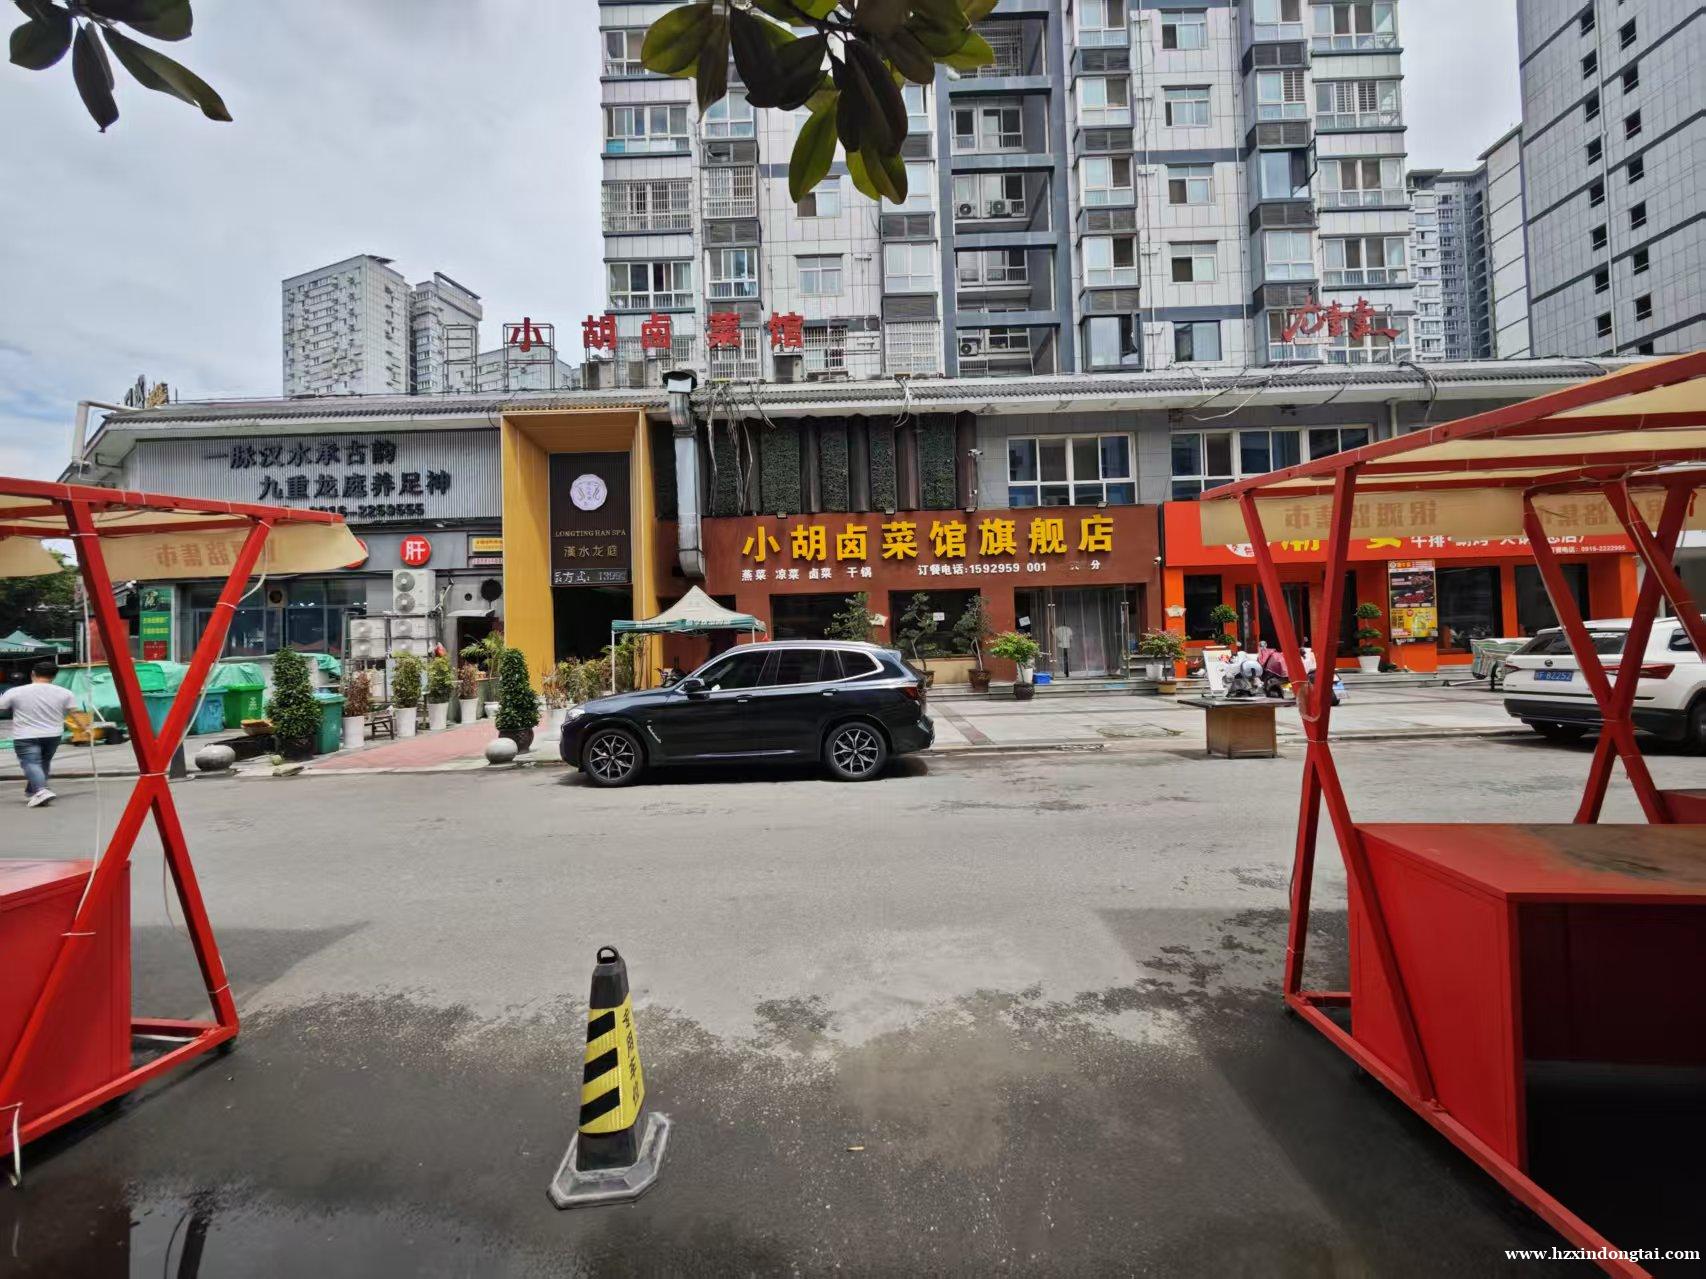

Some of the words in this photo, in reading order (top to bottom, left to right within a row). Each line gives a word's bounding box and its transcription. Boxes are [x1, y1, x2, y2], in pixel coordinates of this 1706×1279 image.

[509, 311, 804, 352] 小胡卤菜馆
[742, 514, 1114, 562] 小胡卤菜馆旗舰店
[1027, 562, 1047, 572] 001
